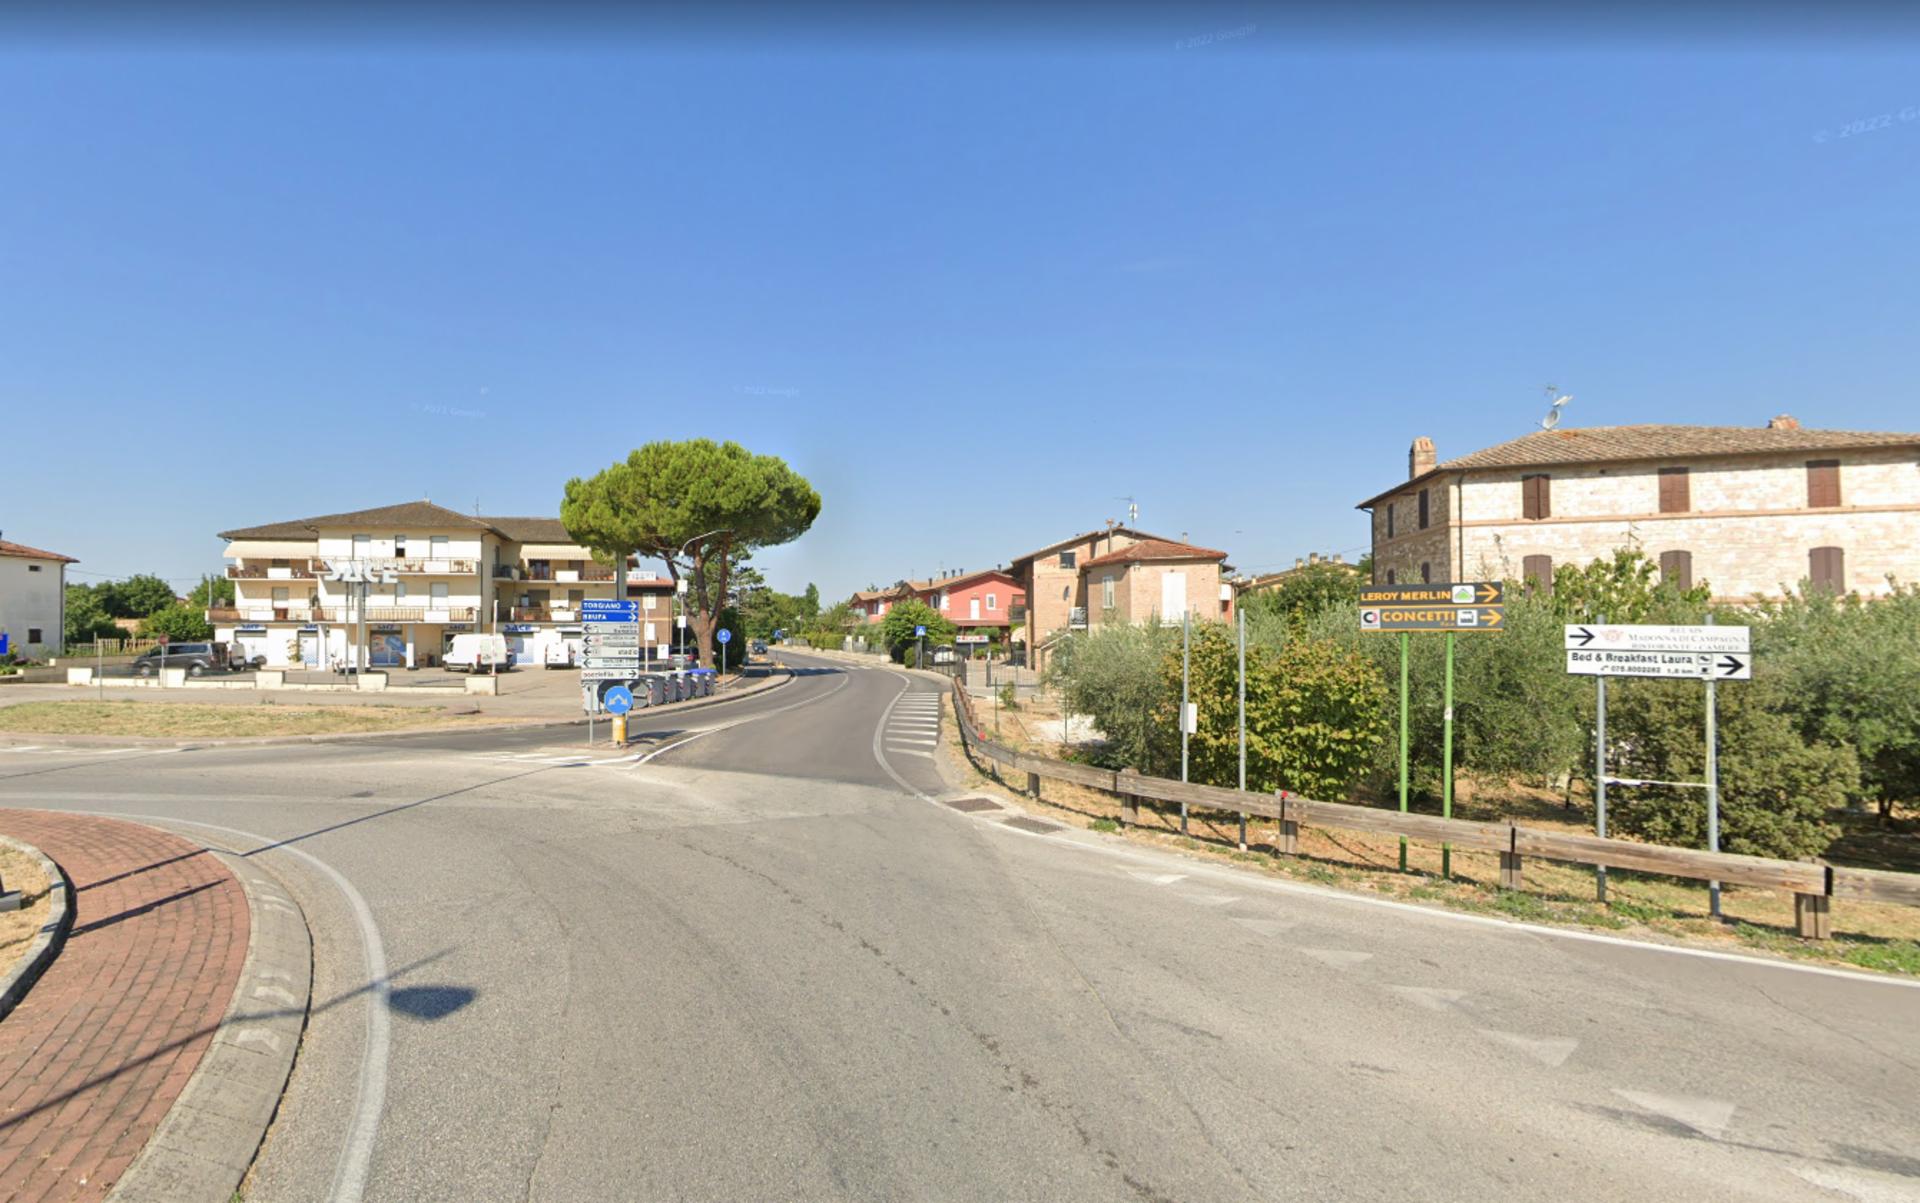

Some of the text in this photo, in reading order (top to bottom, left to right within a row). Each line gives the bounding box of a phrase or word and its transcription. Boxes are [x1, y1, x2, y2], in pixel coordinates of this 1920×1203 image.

[1361, 590, 1451, 601] LEROY MERLIN
[583, 602, 621, 610] TORGIANO
[1382, 610, 1456, 622] CONCETTI
[1571, 652, 1693, 664] Bed & Breakfast Laura
